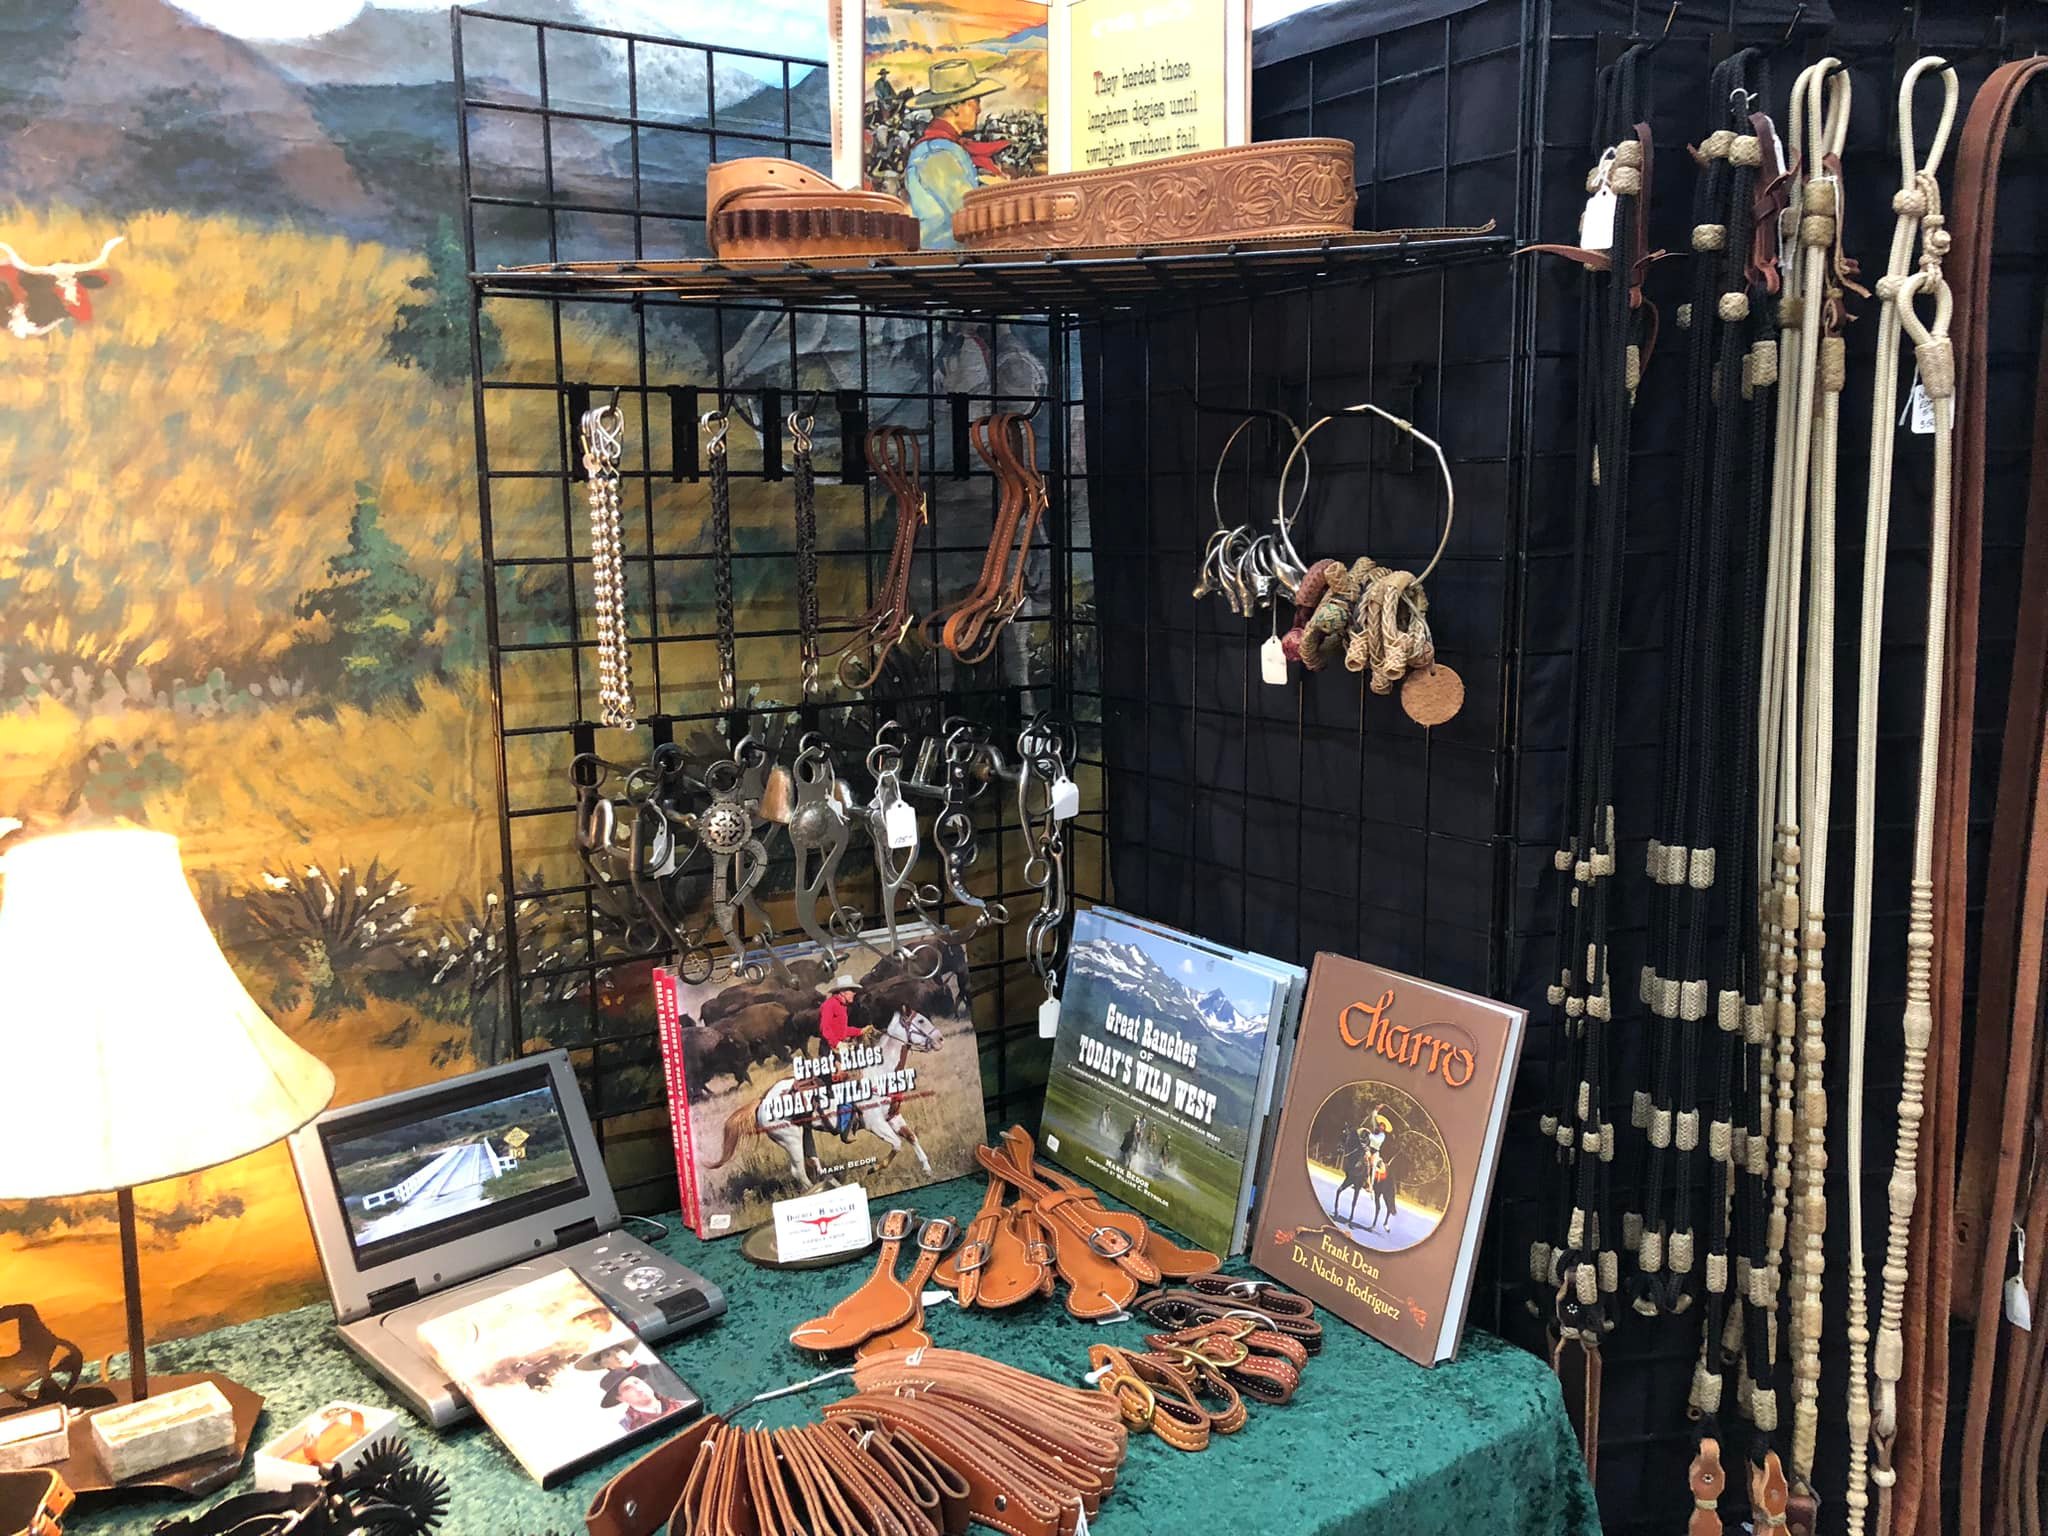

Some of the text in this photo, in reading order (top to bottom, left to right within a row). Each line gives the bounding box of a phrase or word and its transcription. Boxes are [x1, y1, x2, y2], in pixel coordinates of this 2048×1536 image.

[1093, 59, 1191, 97] They herded those
[1087, 90, 1198, 134] longhorn dogies until
[1086, 138, 1125, 166] twilight
[1129, 133, 1172, 156] without
[1105, 1002, 1198, 1069] Great Ranches
[1140, 1050, 1154, 1062] OF
[1337, 989, 1475, 1088] Charro
[793, 1043, 883, 1081] Great Rides
[1079, 1034, 1217, 1124] TODAY'S WILD WEST
[763, 1085, 829, 1122] TODAY'S
[832, 1078, 871, 1105] WILD
[872, 1068, 916, 1097] WEST
[1321, 1234, 1380, 1280] Frank Dean
[1292, 1245, 1401, 1321] Dr. Nacho Rodríguez
